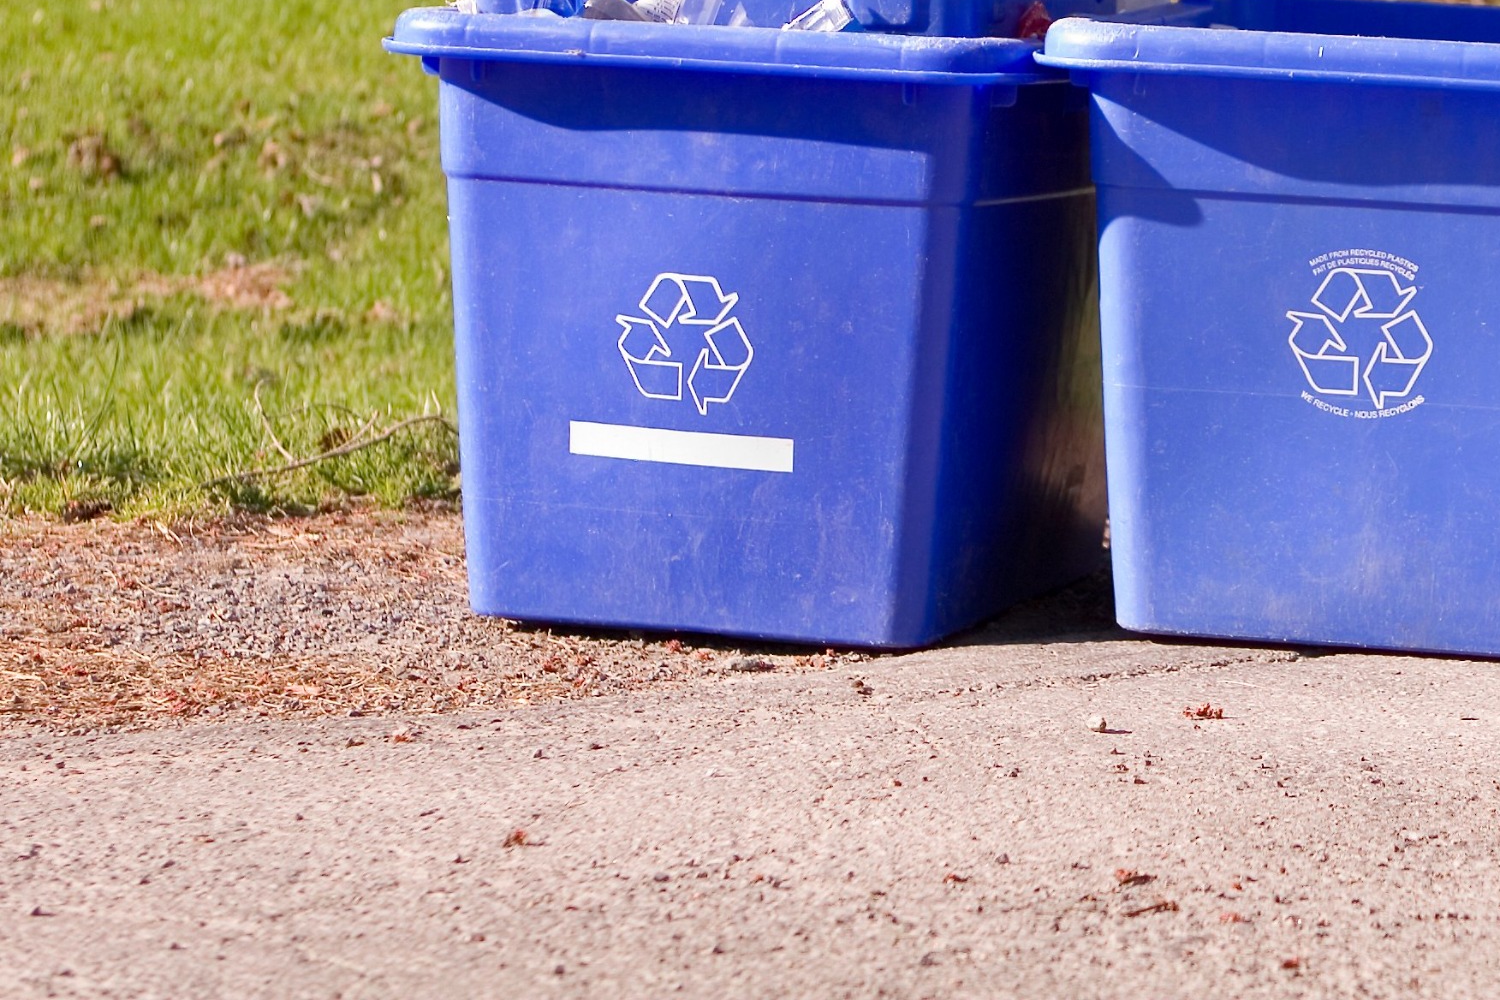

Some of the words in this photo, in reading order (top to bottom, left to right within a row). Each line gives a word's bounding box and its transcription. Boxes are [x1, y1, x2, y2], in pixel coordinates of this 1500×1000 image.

[1309, 254, 1328, 266] MADE
[1329, 250, 1349, 259] FROM
[1350, 249, 1387, 258] RECYCLED
[1387, 253, 1419, 272] PLASTICS
[1312, 265, 1328, 276] FAIT
[1327, 260, 1337, 269] DE
[1338, 257, 1380, 266] PLASTIQUES
[1301, 390, 1313, 403] WE
[1312, 398, 1349, 417] RECYCLE
[1354, 410, 1378, 419] NOUS
[1379, 395, 1425, 418] RECYCLONS
